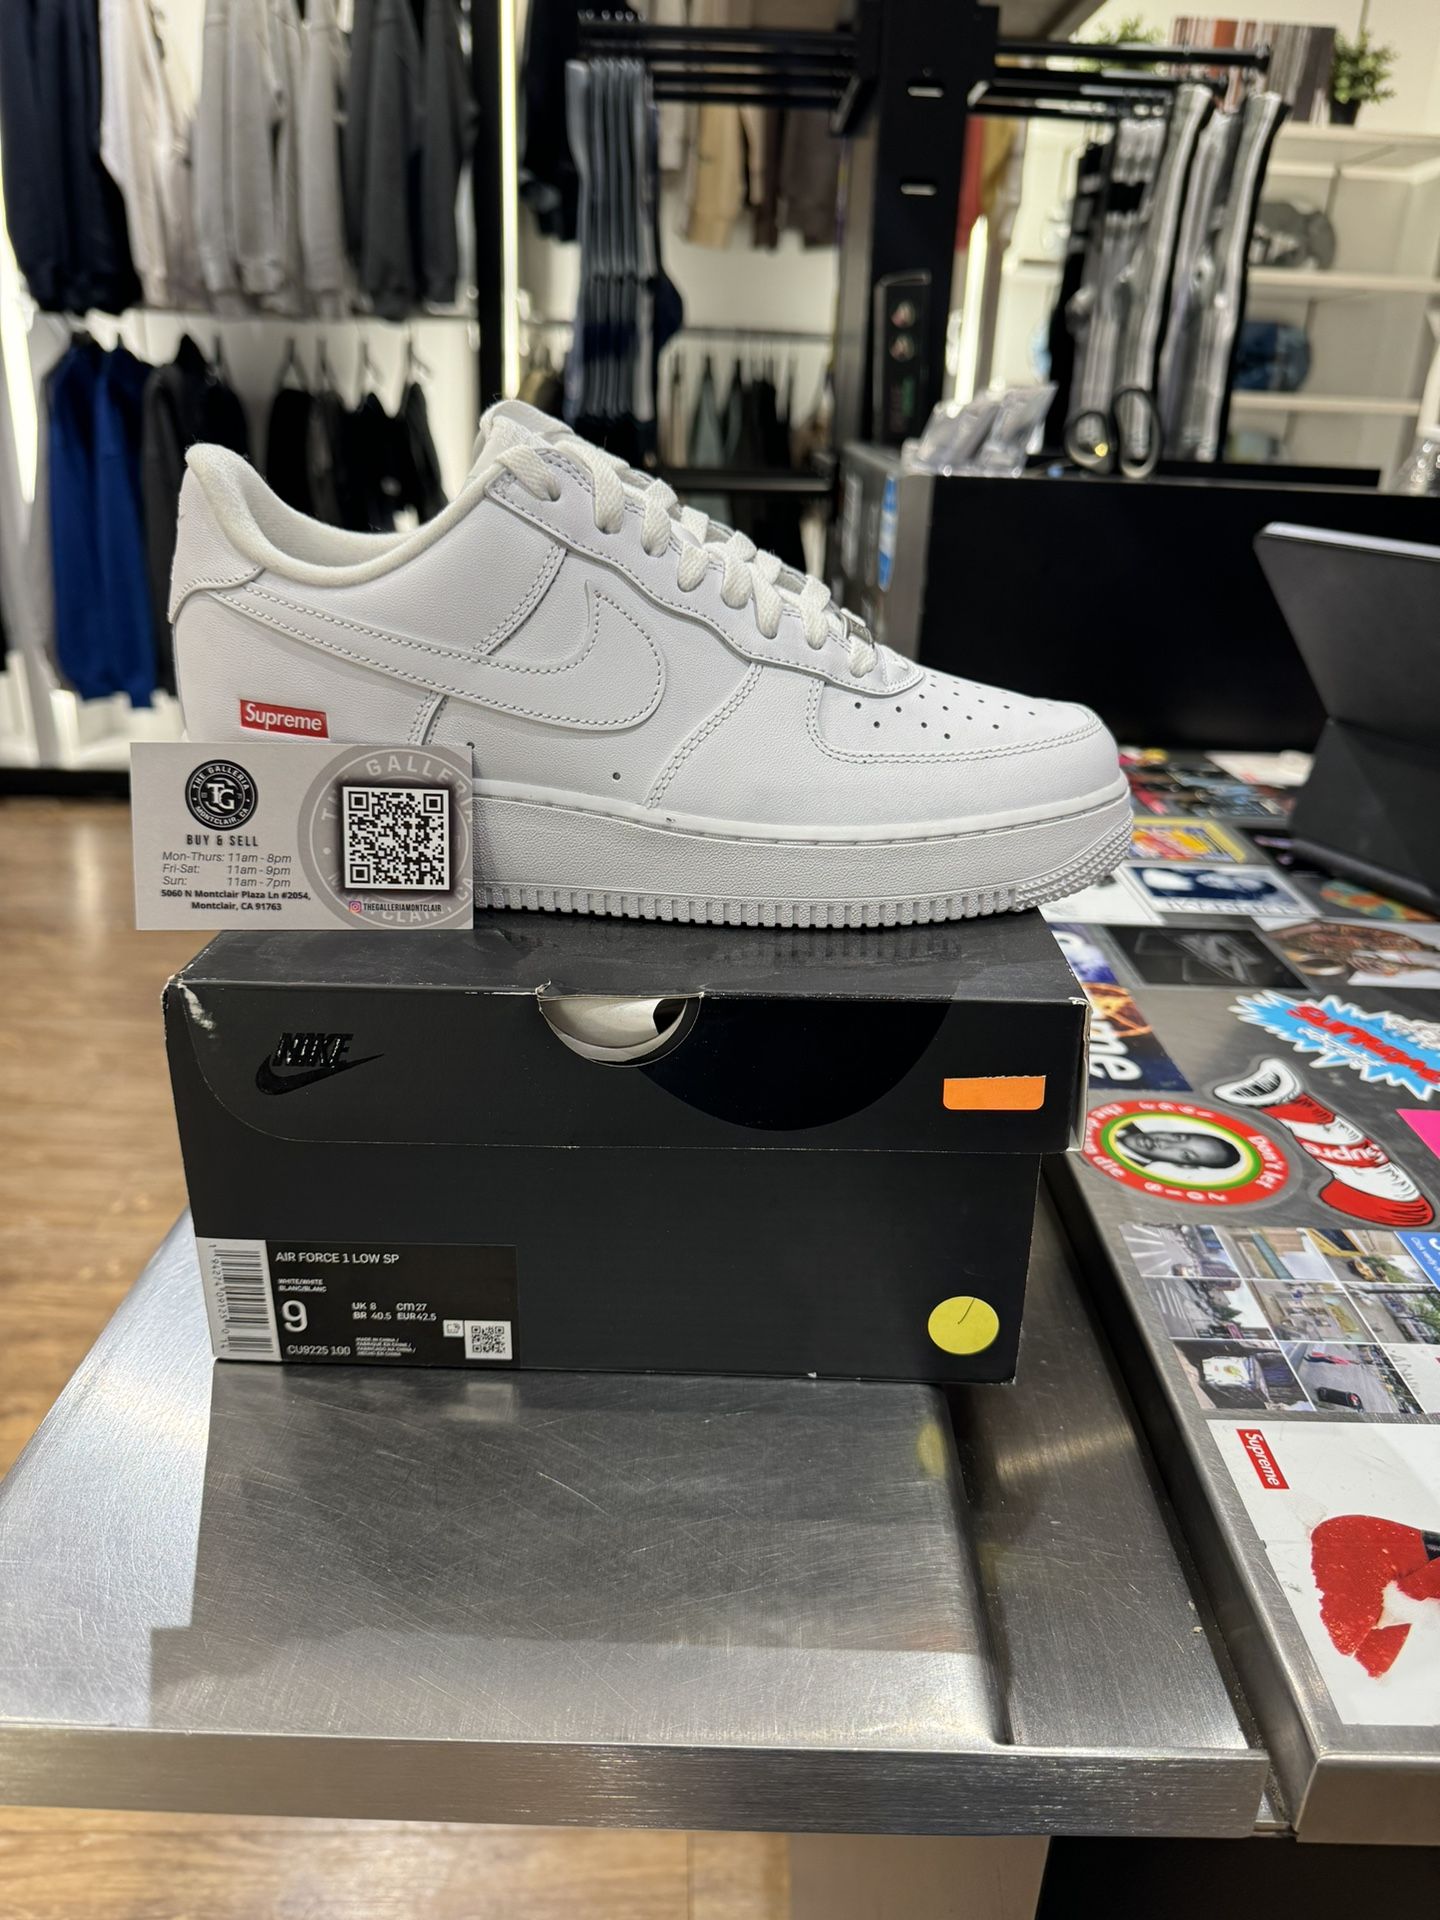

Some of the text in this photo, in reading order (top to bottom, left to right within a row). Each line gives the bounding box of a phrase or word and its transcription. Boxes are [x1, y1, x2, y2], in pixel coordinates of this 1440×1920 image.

[245, 703, 322, 731] Supreme
[192, 765, 250, 790] THE GALLERIA
[239, 808, 249, 818] CA
[186, 834, 259, 847] BUY & SELL
[162, 851, 225, 862] Mon-Thurs:
[228, 853, 258, 863] 11am
[267, 854, 292, 865] 8pm
[162, 864, 200, 874] Fri-Sat:
[227, 865, 257, 875] 11am
[266, 866, 291, 878] 9pm
[162, 876, 187, 886] Sun:
[227, 877, 257, 887] 11am
[266, 878, 291, 889] 7pm
[161, 889, 183, 897] 5060
[185, 890, 193, 898] N
[194, 890, 239, 899] Montclair
[241, 891, 265, 899] Plaza
[281, 892, 311, 901] #2054,
[191, 902, 282, 911] Montclair, CA 91763
[363, 902, 442, 912] THEGALLERIAMONTCLAIR
[272, 1032, 354, 1067] NIKE
[1092, 1155, 1127, 1178] die
[1247, 1135, 1285, 1189] Don't let
[1144, 1181, 1227, 1202] 2018
[275, 1252, 399, 1264] AIR FORCE 1 LOW SP
[352, 1302, 367, 1310] UK
[370, 1302, 377, 1310] 8
[416, 1303, 427, 1311] 27
[282, 1300, 308, 1332] 9
[353, 1312, 437, 1321] BR 40.5 EUR 42.5
[331, 1345, 351, 1356] 100
[1244, 1432, 1280, 1486] Supreme
